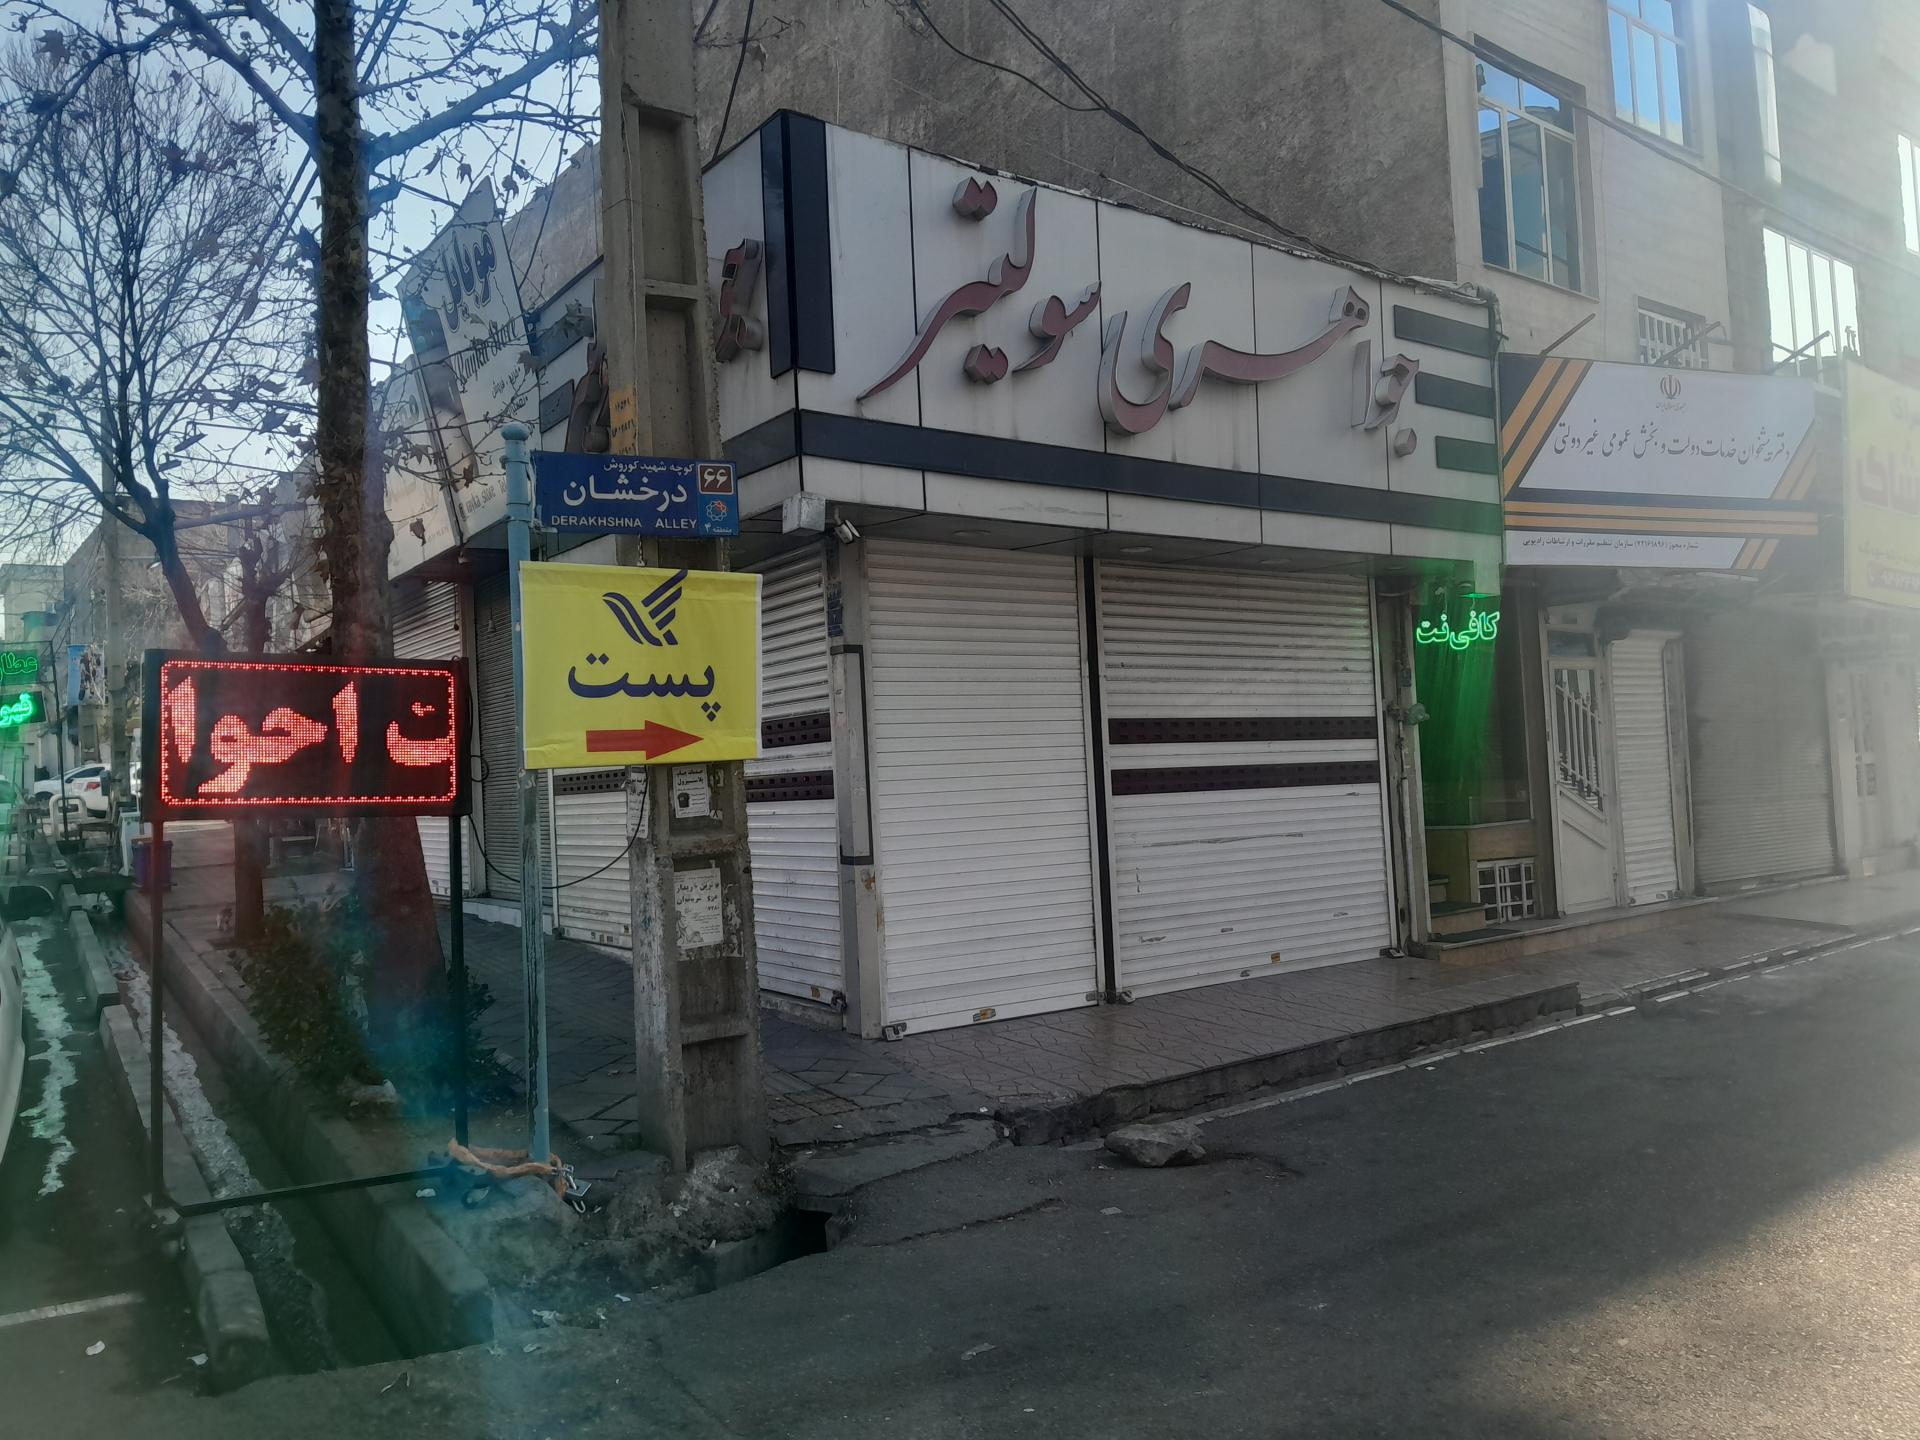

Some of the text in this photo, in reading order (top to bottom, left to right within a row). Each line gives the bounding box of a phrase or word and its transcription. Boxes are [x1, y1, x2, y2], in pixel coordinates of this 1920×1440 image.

[443, 230, 497, 332] موبایل
[1097, 282, 1419, 457] جواهری
[1601, 429, 1631, 457] عمومی
[1633, 421, 1659, 459] بخش
[1661, 442, 1666, 453] و
[1667, 435, 1700, 456] دولت
[1701, 437, 1737, 458] خدمات
[603, 457, 695, 476] کوچه شهید کوروش
[703, 468, 729, 489] ۶۶
[563, 474, 688, 512] درخشان
[551, 515, 697, 529] DERAKHSHNA ALLEY
[1416, 610, 1500, 650] کافی نت
[568, 652, 722, 722] پست
